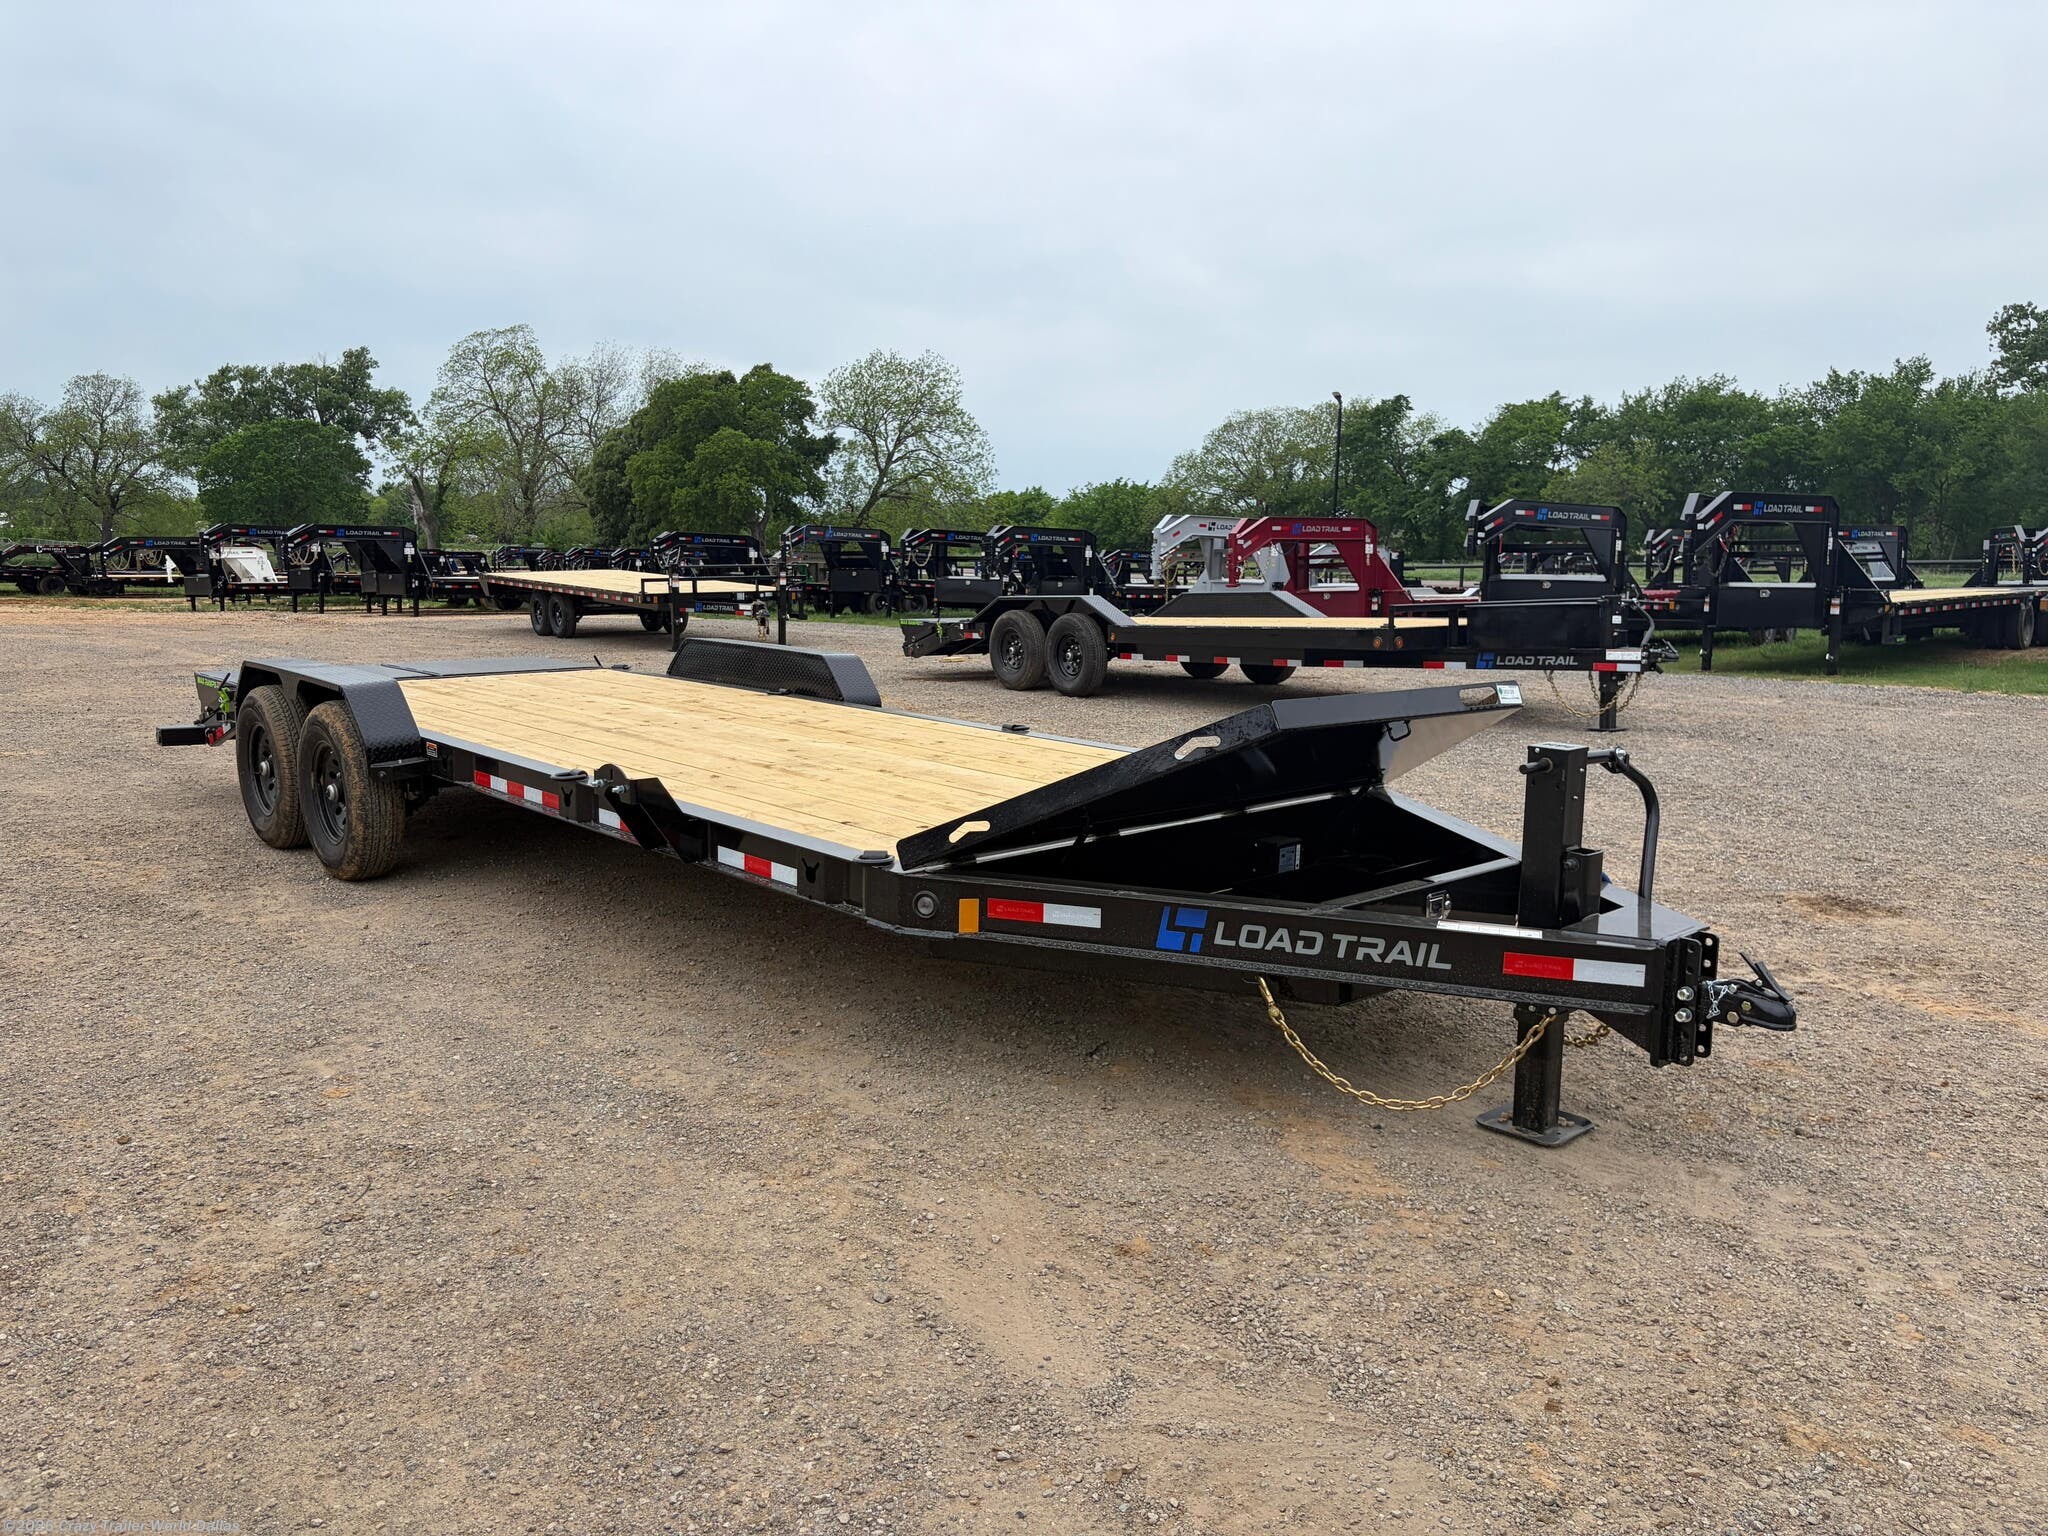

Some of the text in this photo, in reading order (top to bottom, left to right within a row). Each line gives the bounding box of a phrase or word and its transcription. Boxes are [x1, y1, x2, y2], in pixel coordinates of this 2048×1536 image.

[1763, 504, 1803, 513] LOAD TRAIL
[1548, 511, 1590, 520] LOAD TRAIL
[1496, 655, 1578, 666] LOAD TRAIL
[1214, 921, 1452, 970] LOAD TRAIL
